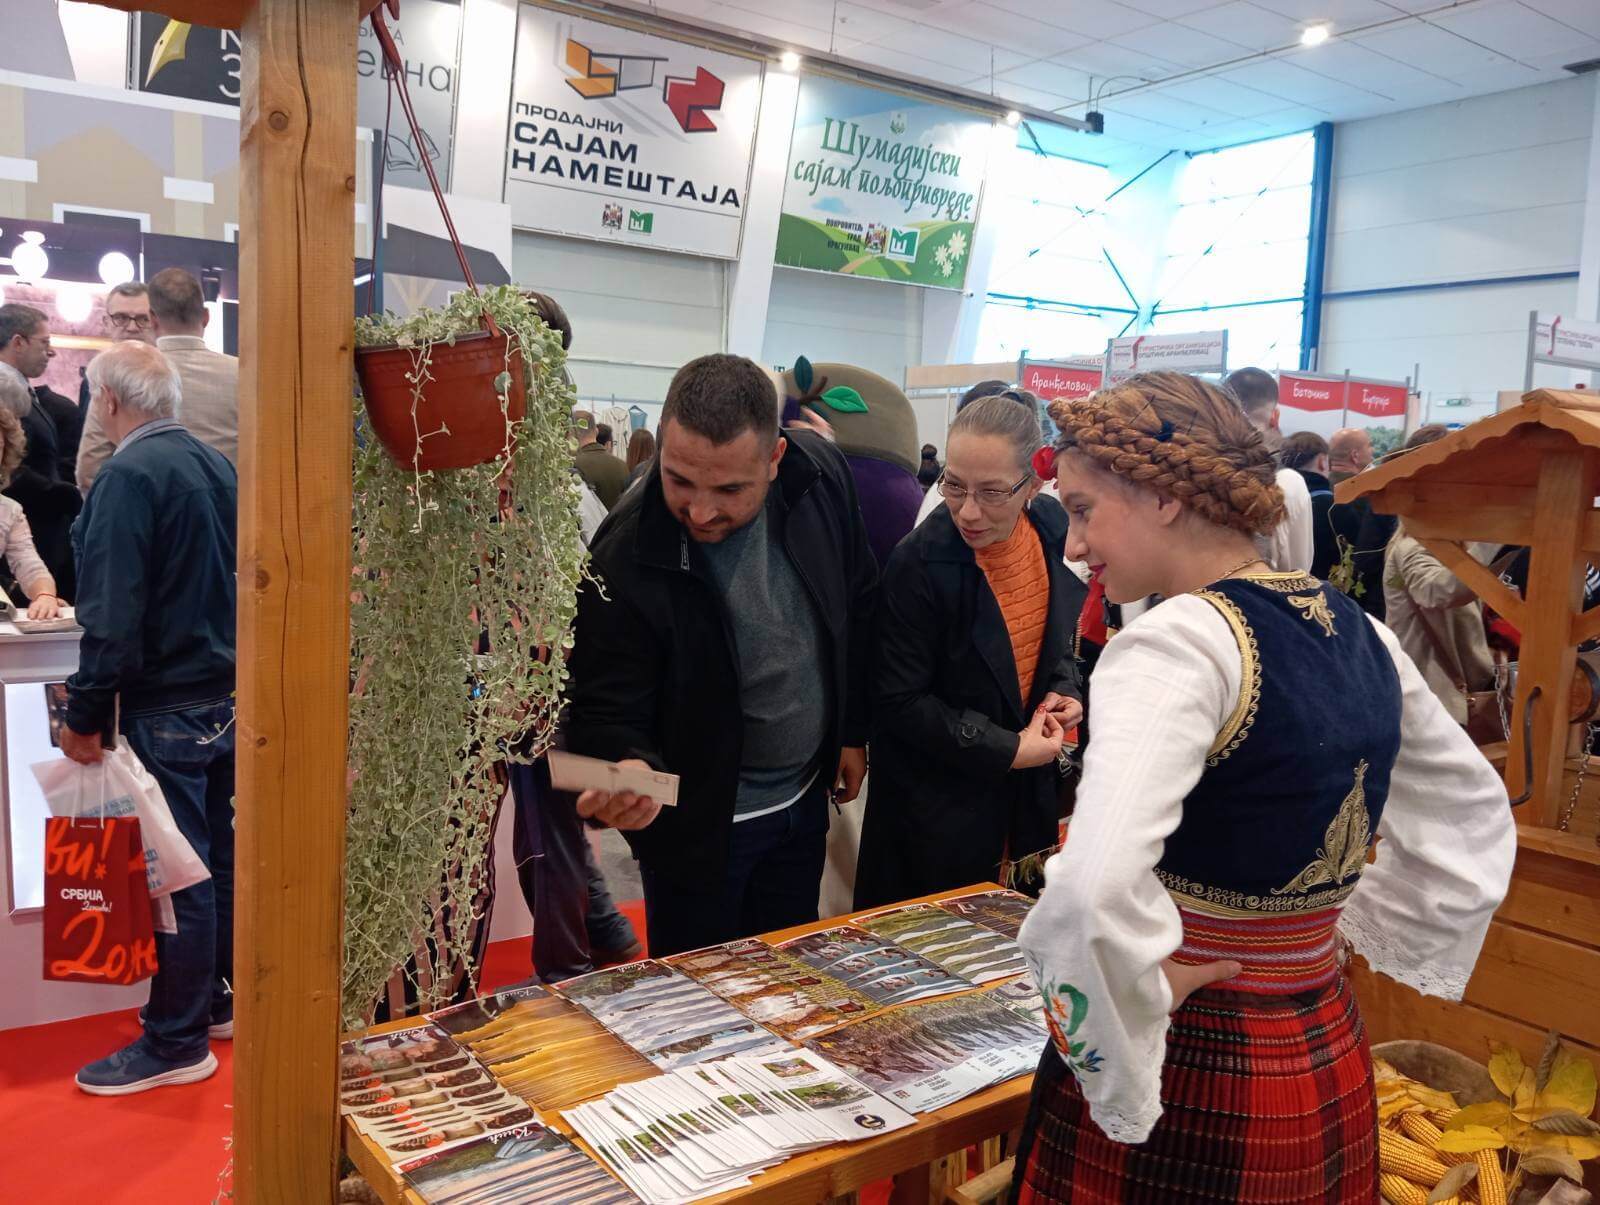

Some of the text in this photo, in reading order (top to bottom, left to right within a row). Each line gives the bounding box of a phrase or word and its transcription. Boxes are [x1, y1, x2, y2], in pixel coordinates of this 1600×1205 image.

[515, 102, 623, 134] ПРОДАЈНИ
[514, 121, 638, 163] САЈАМ
[820, 116, 962, 180] Шумадијски
[511, 149, 740, 207] НАМЕШТАЈА
[793, 158, 852, 196] сајам
[61, 888, 104, 901] СРБИЈА
